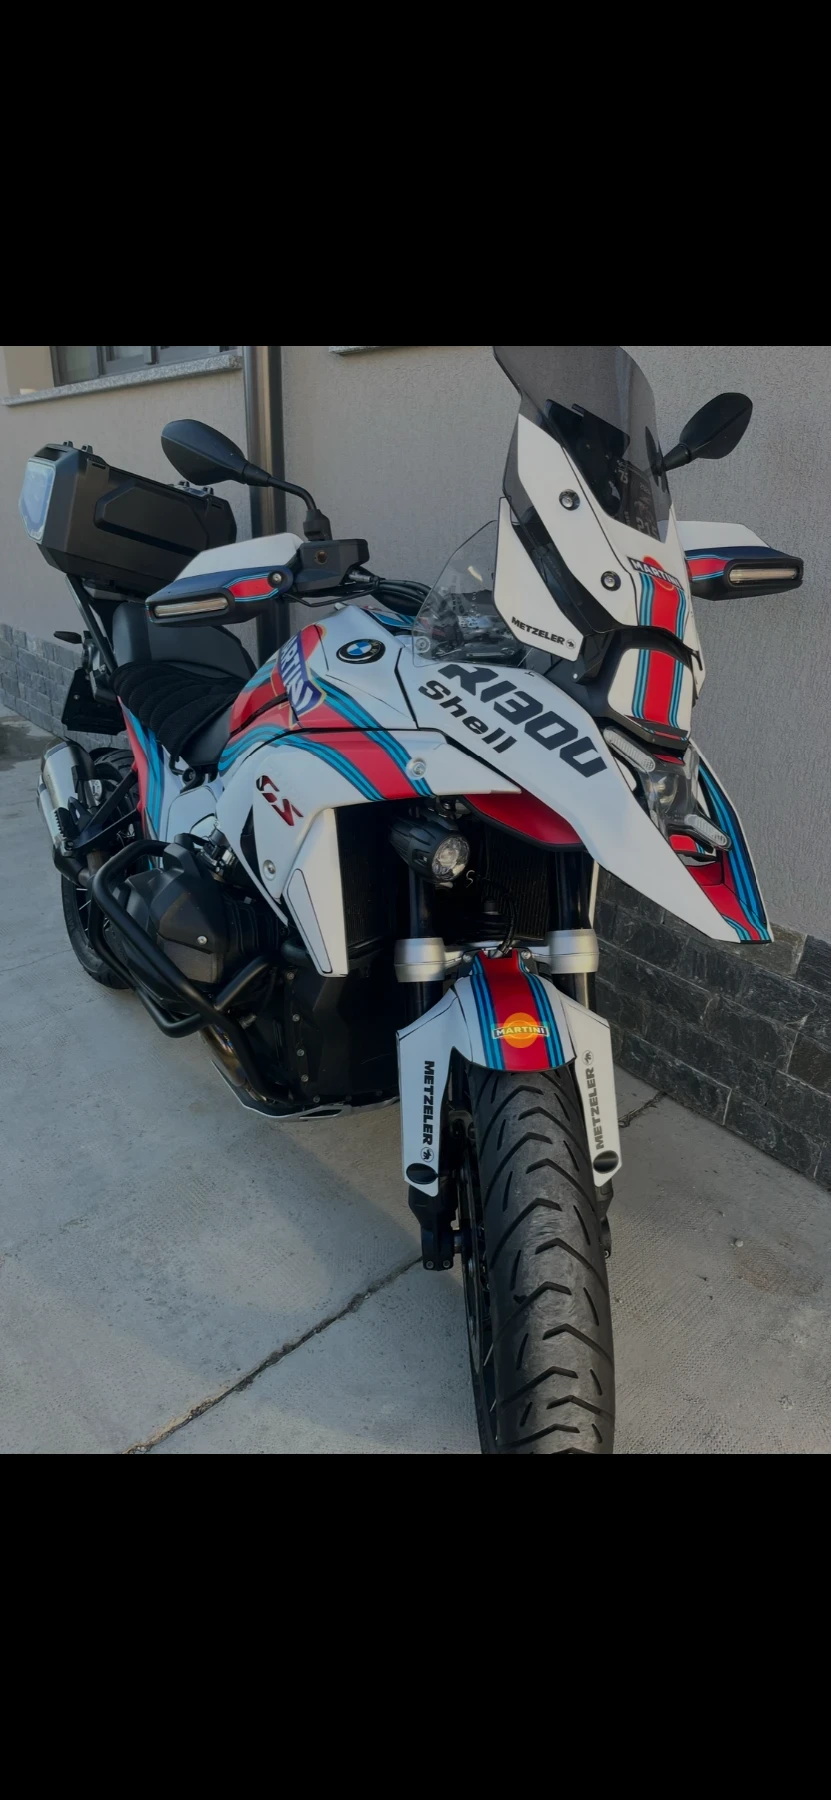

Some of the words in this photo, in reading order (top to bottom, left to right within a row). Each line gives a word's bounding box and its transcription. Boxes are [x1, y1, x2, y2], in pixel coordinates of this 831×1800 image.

[632, 560, 680, 589] MARTINI
[511, 616, 565, 645] METZELER
[418, 680, 518, 754] Shell
[495, 1025, 546, 1037] MARTINI
[422, 1060, 435, 1146] METZELER
[585, 1067, 605, 1150] METZELER
